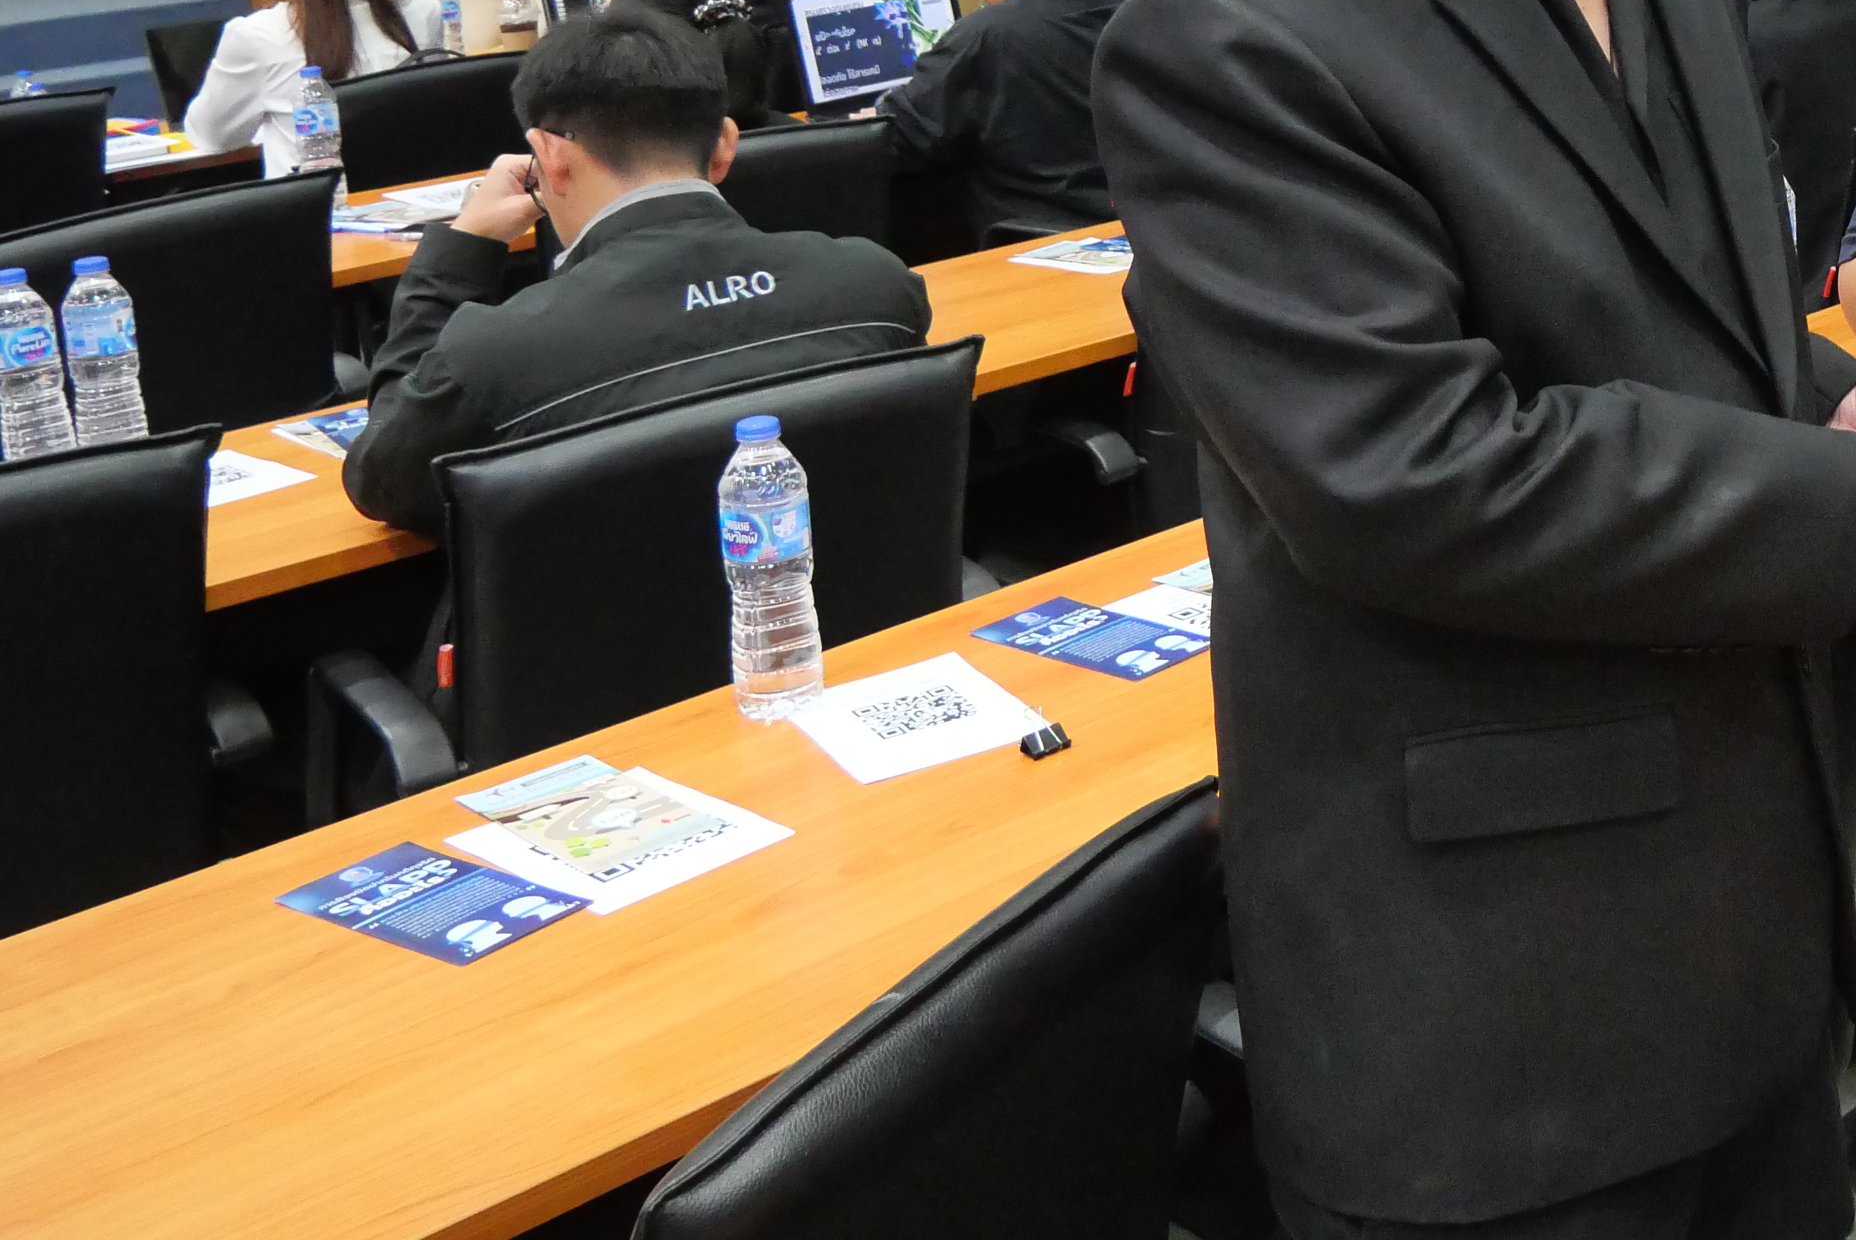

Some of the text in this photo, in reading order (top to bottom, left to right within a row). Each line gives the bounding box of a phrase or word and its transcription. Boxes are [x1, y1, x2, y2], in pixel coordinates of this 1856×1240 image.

[685, 270, 777, 312] ALRO
[1014, 608, 1103, 647] SLAPP
[328, 858, 453, 917] SLAPP
